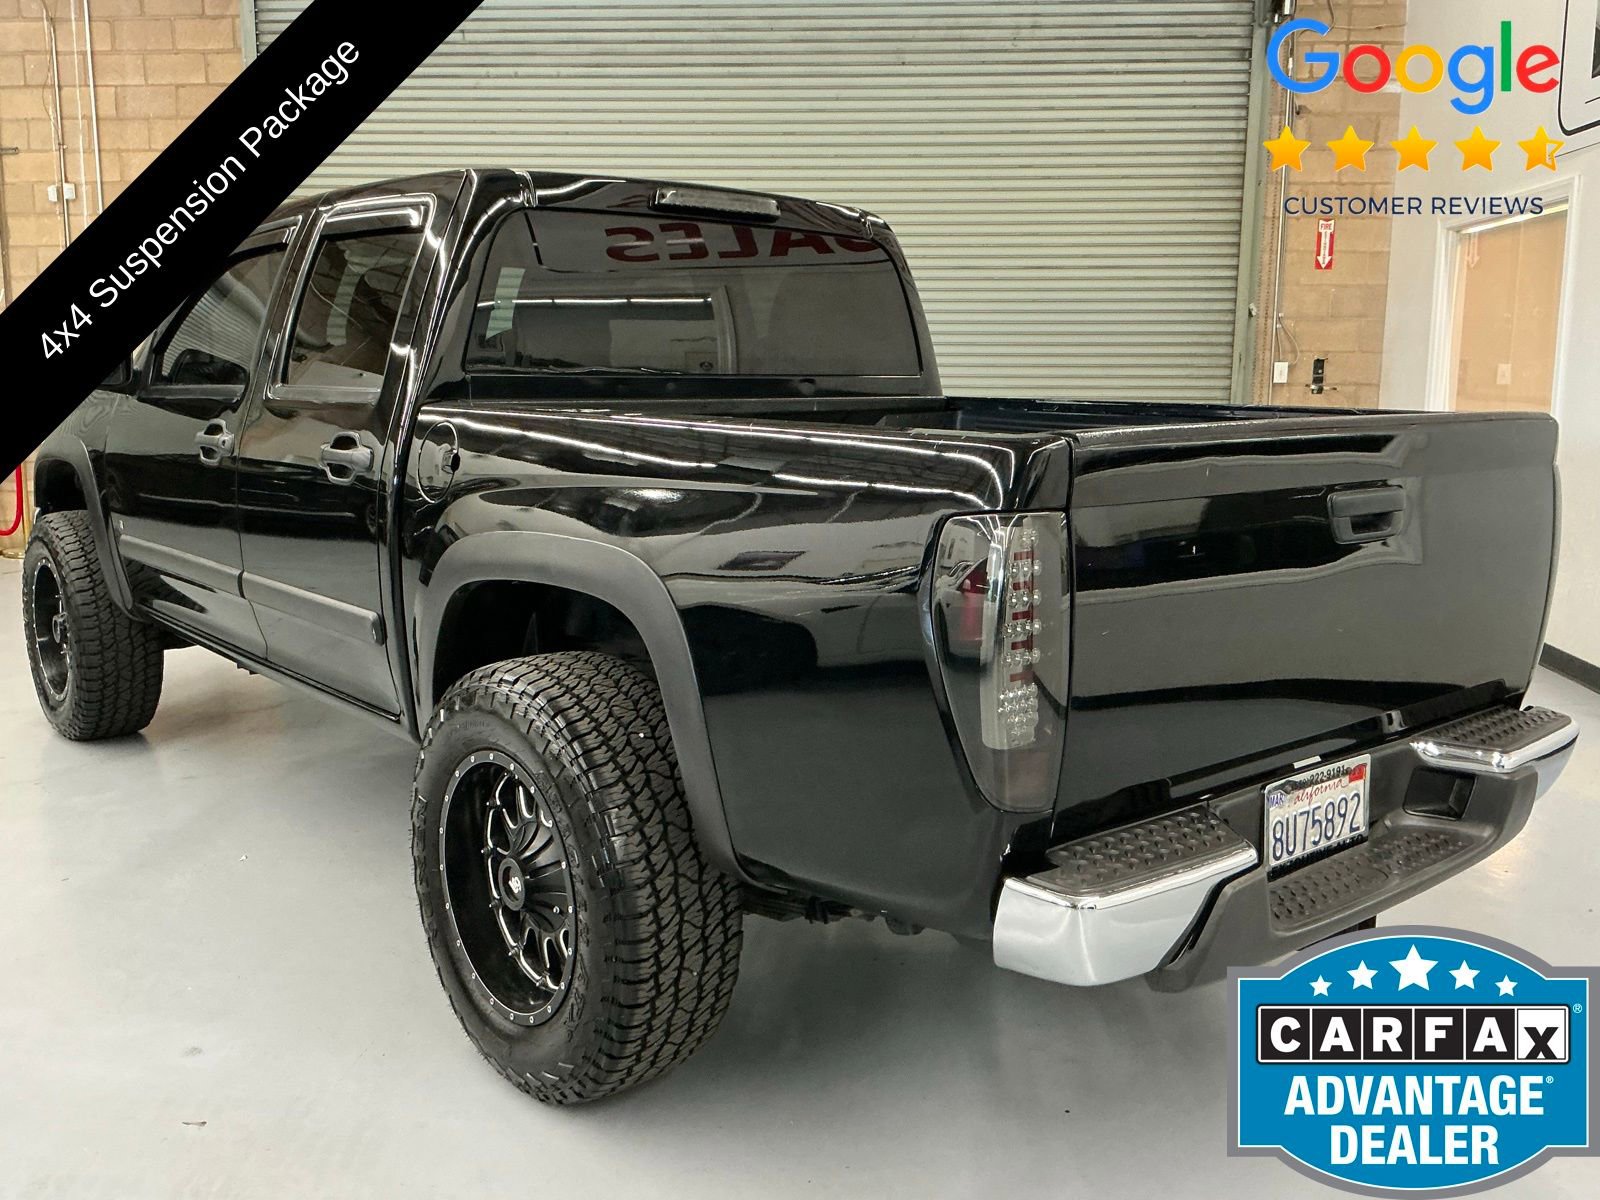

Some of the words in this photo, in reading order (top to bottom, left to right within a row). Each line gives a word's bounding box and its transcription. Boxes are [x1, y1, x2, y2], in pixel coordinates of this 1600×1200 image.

[1320, 222, 1333, 231] FIRE
[1293, 778, 1349, 807] alifornia
[1272, 792, 1361, 862] 8U75892
